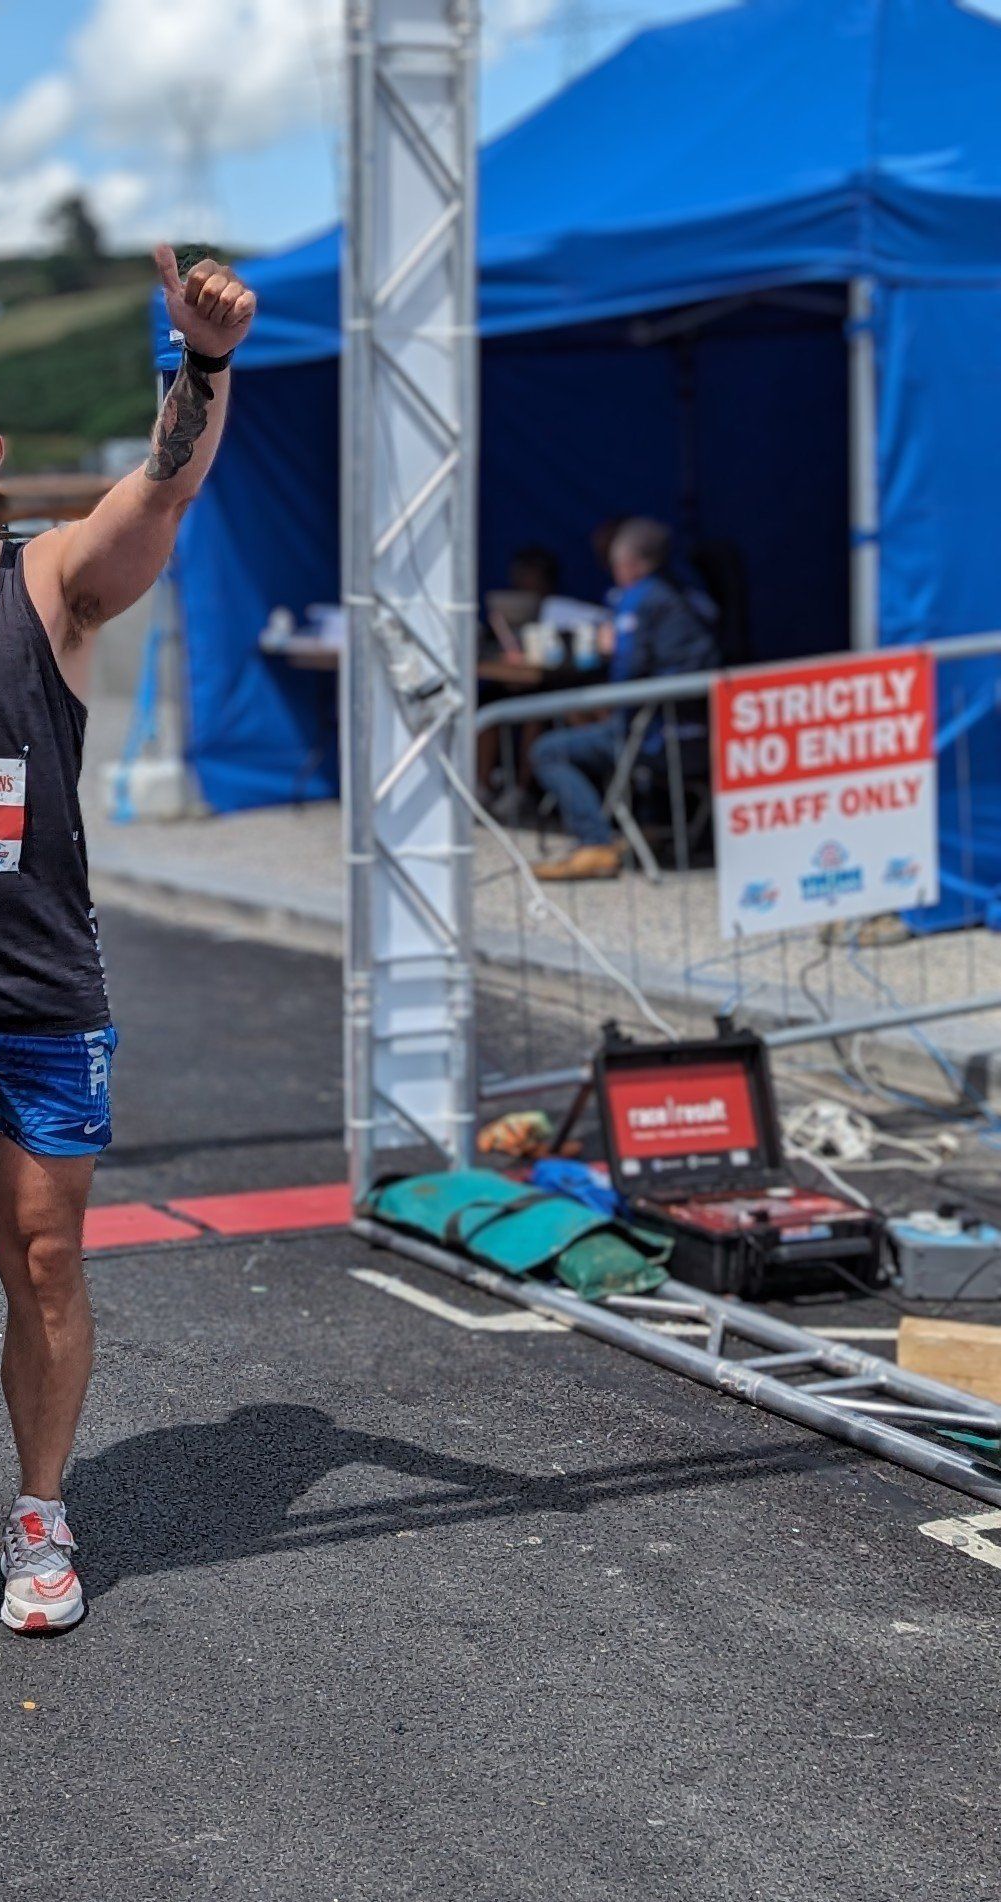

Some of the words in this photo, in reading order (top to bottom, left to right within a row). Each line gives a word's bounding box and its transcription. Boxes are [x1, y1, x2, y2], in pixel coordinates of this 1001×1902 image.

[731, 667, 917, 733] STRICTLY
[725, 733, 789, 780] NO
[796, 713, 925, 770] ENTRY
[729, 792, 829, 836] STAFF
[841, 777, 922, 818] ONLY
